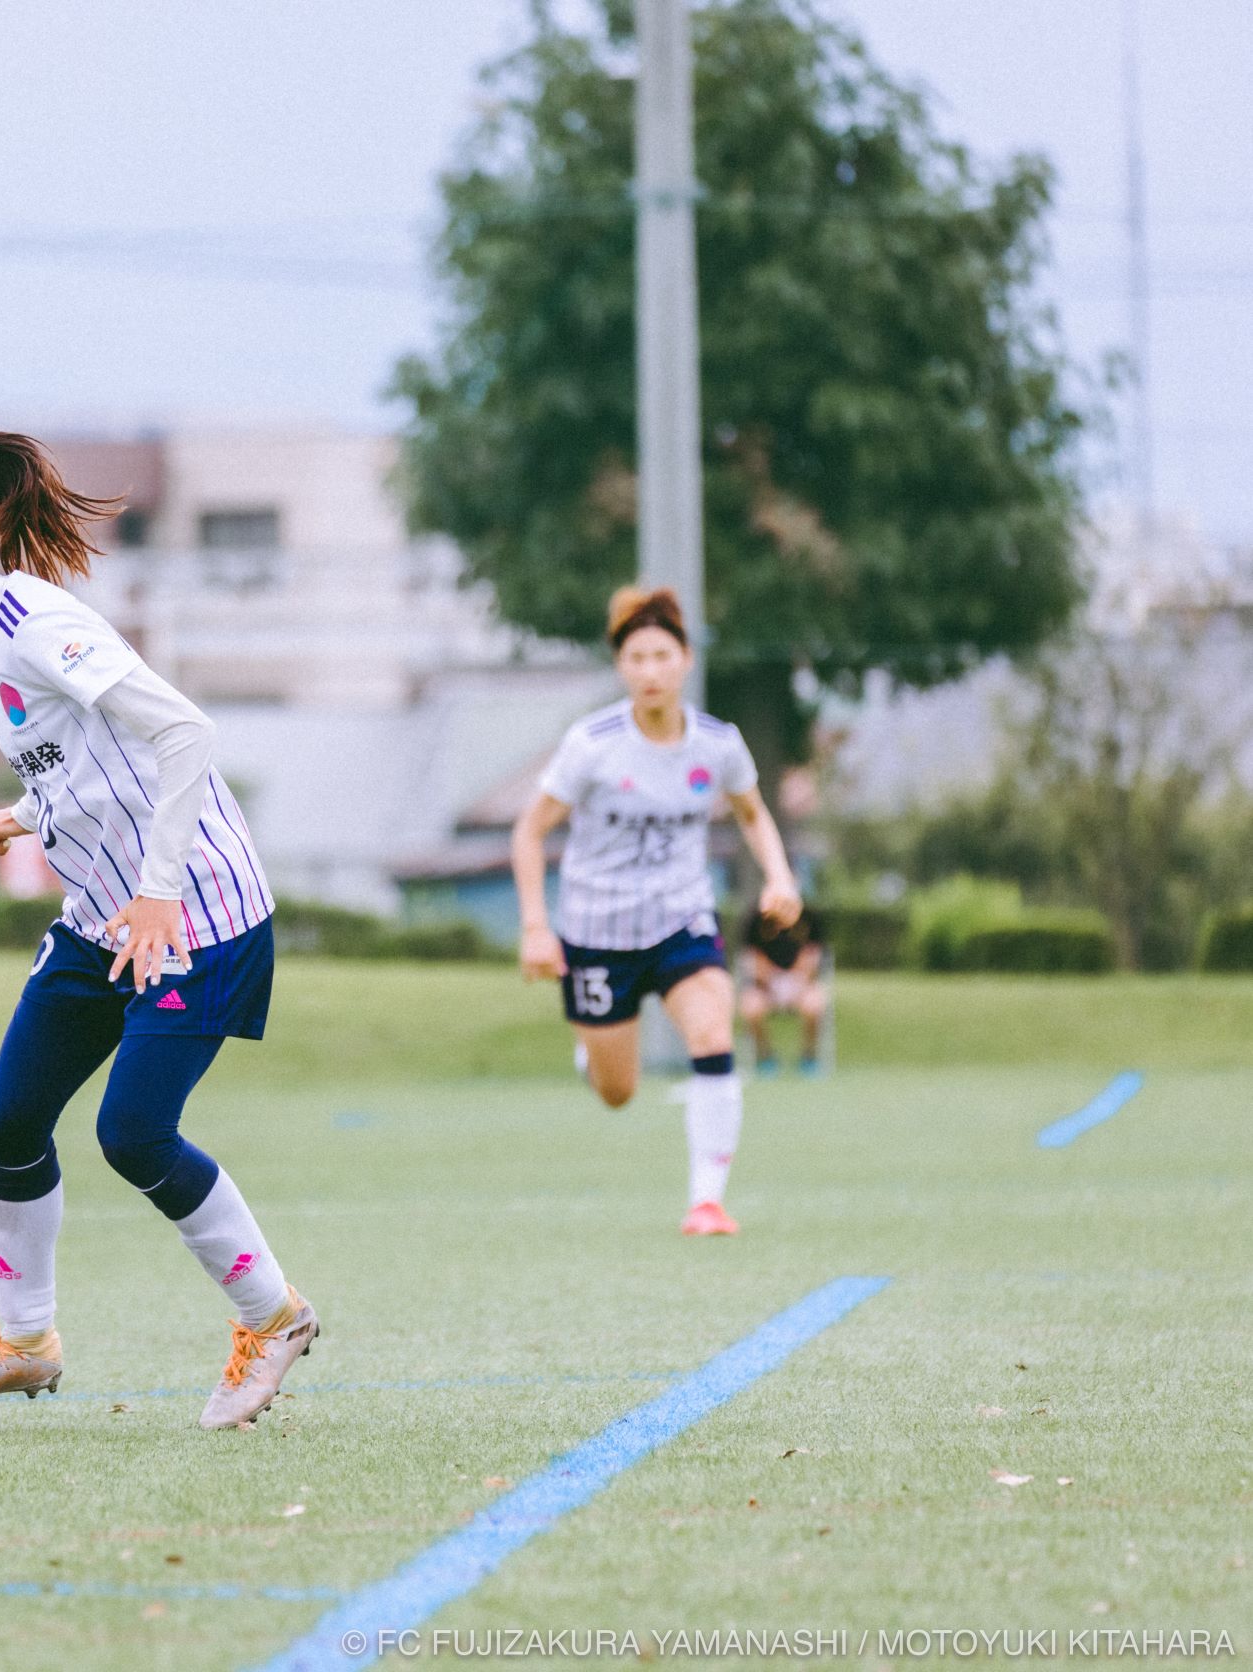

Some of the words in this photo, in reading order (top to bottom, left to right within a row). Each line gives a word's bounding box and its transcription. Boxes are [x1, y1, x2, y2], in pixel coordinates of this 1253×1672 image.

[62, 645, 96, 675] Kim-Tech
[156, 1001, 187, 1010] adidas
[572, 965, 614, 1017] 13
